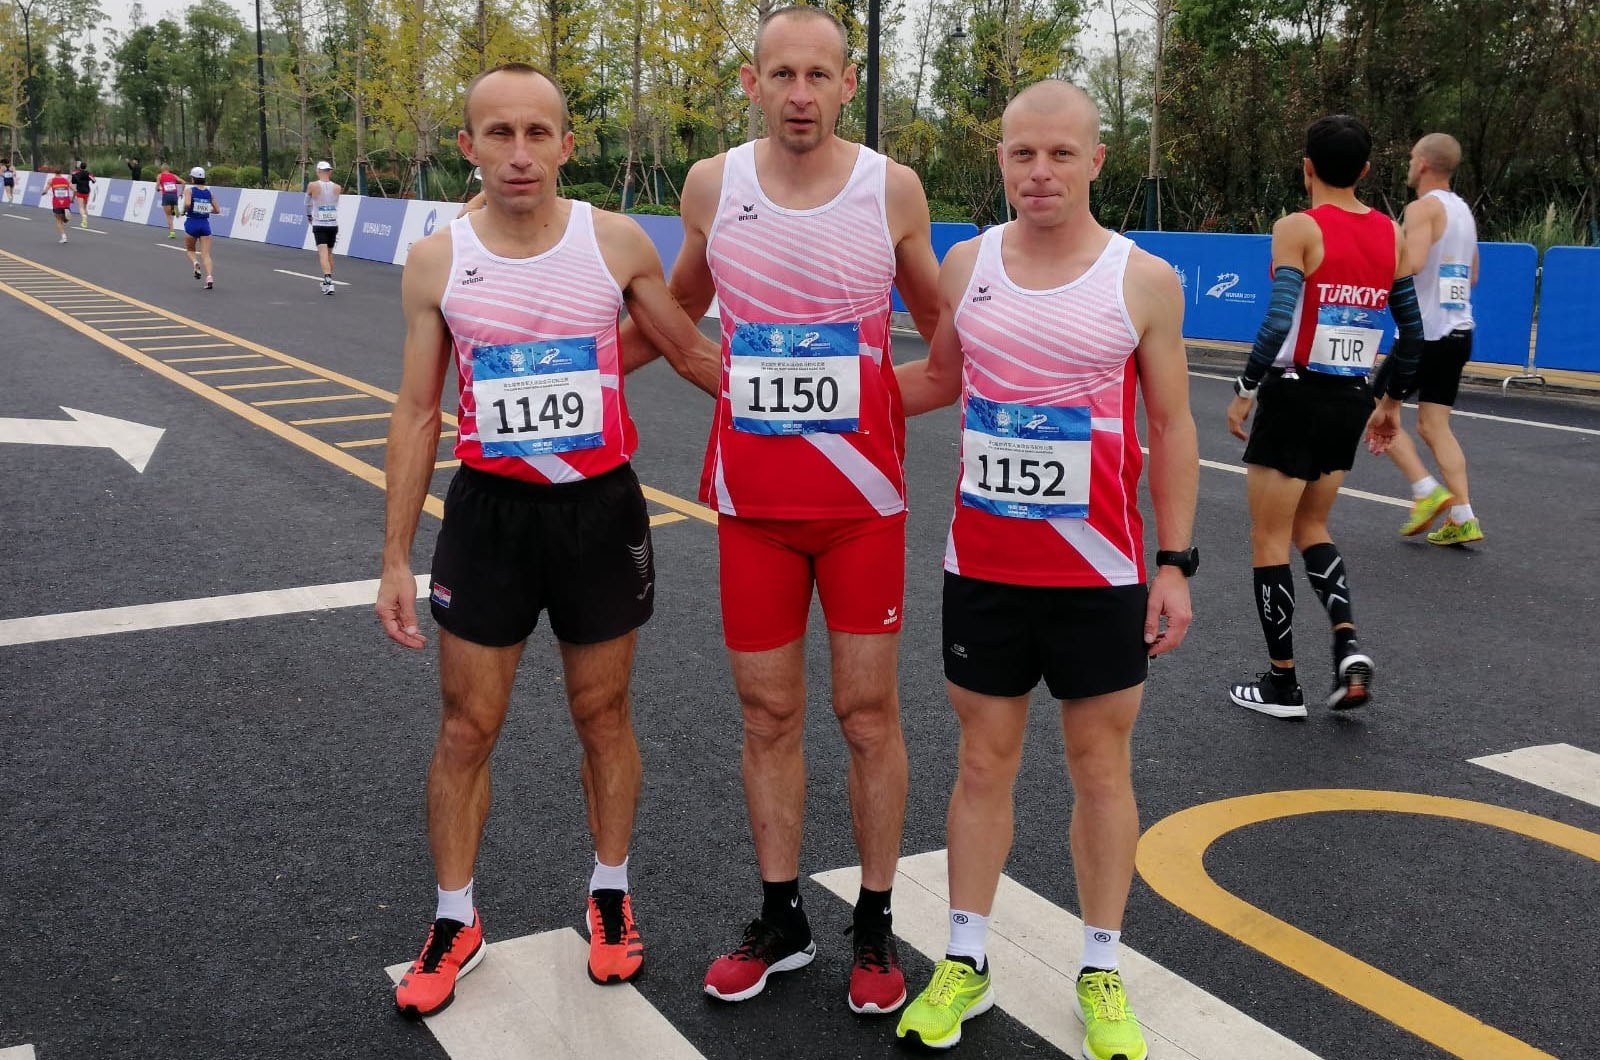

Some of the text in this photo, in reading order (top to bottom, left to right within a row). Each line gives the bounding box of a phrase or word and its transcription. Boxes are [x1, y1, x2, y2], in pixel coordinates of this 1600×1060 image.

[738, 213, 758, 221] erima
[461, 276, 484, 286] erima
[973, 295, 992, 303] erima
[1329, 338, 1363, 362] TUR
[748, 376, 839, 413] 1150
[492, 391, 585, 435] 1149
[978, 454, 1066, 497] 1152
[1262, 583, 1273, 621] 2XU
